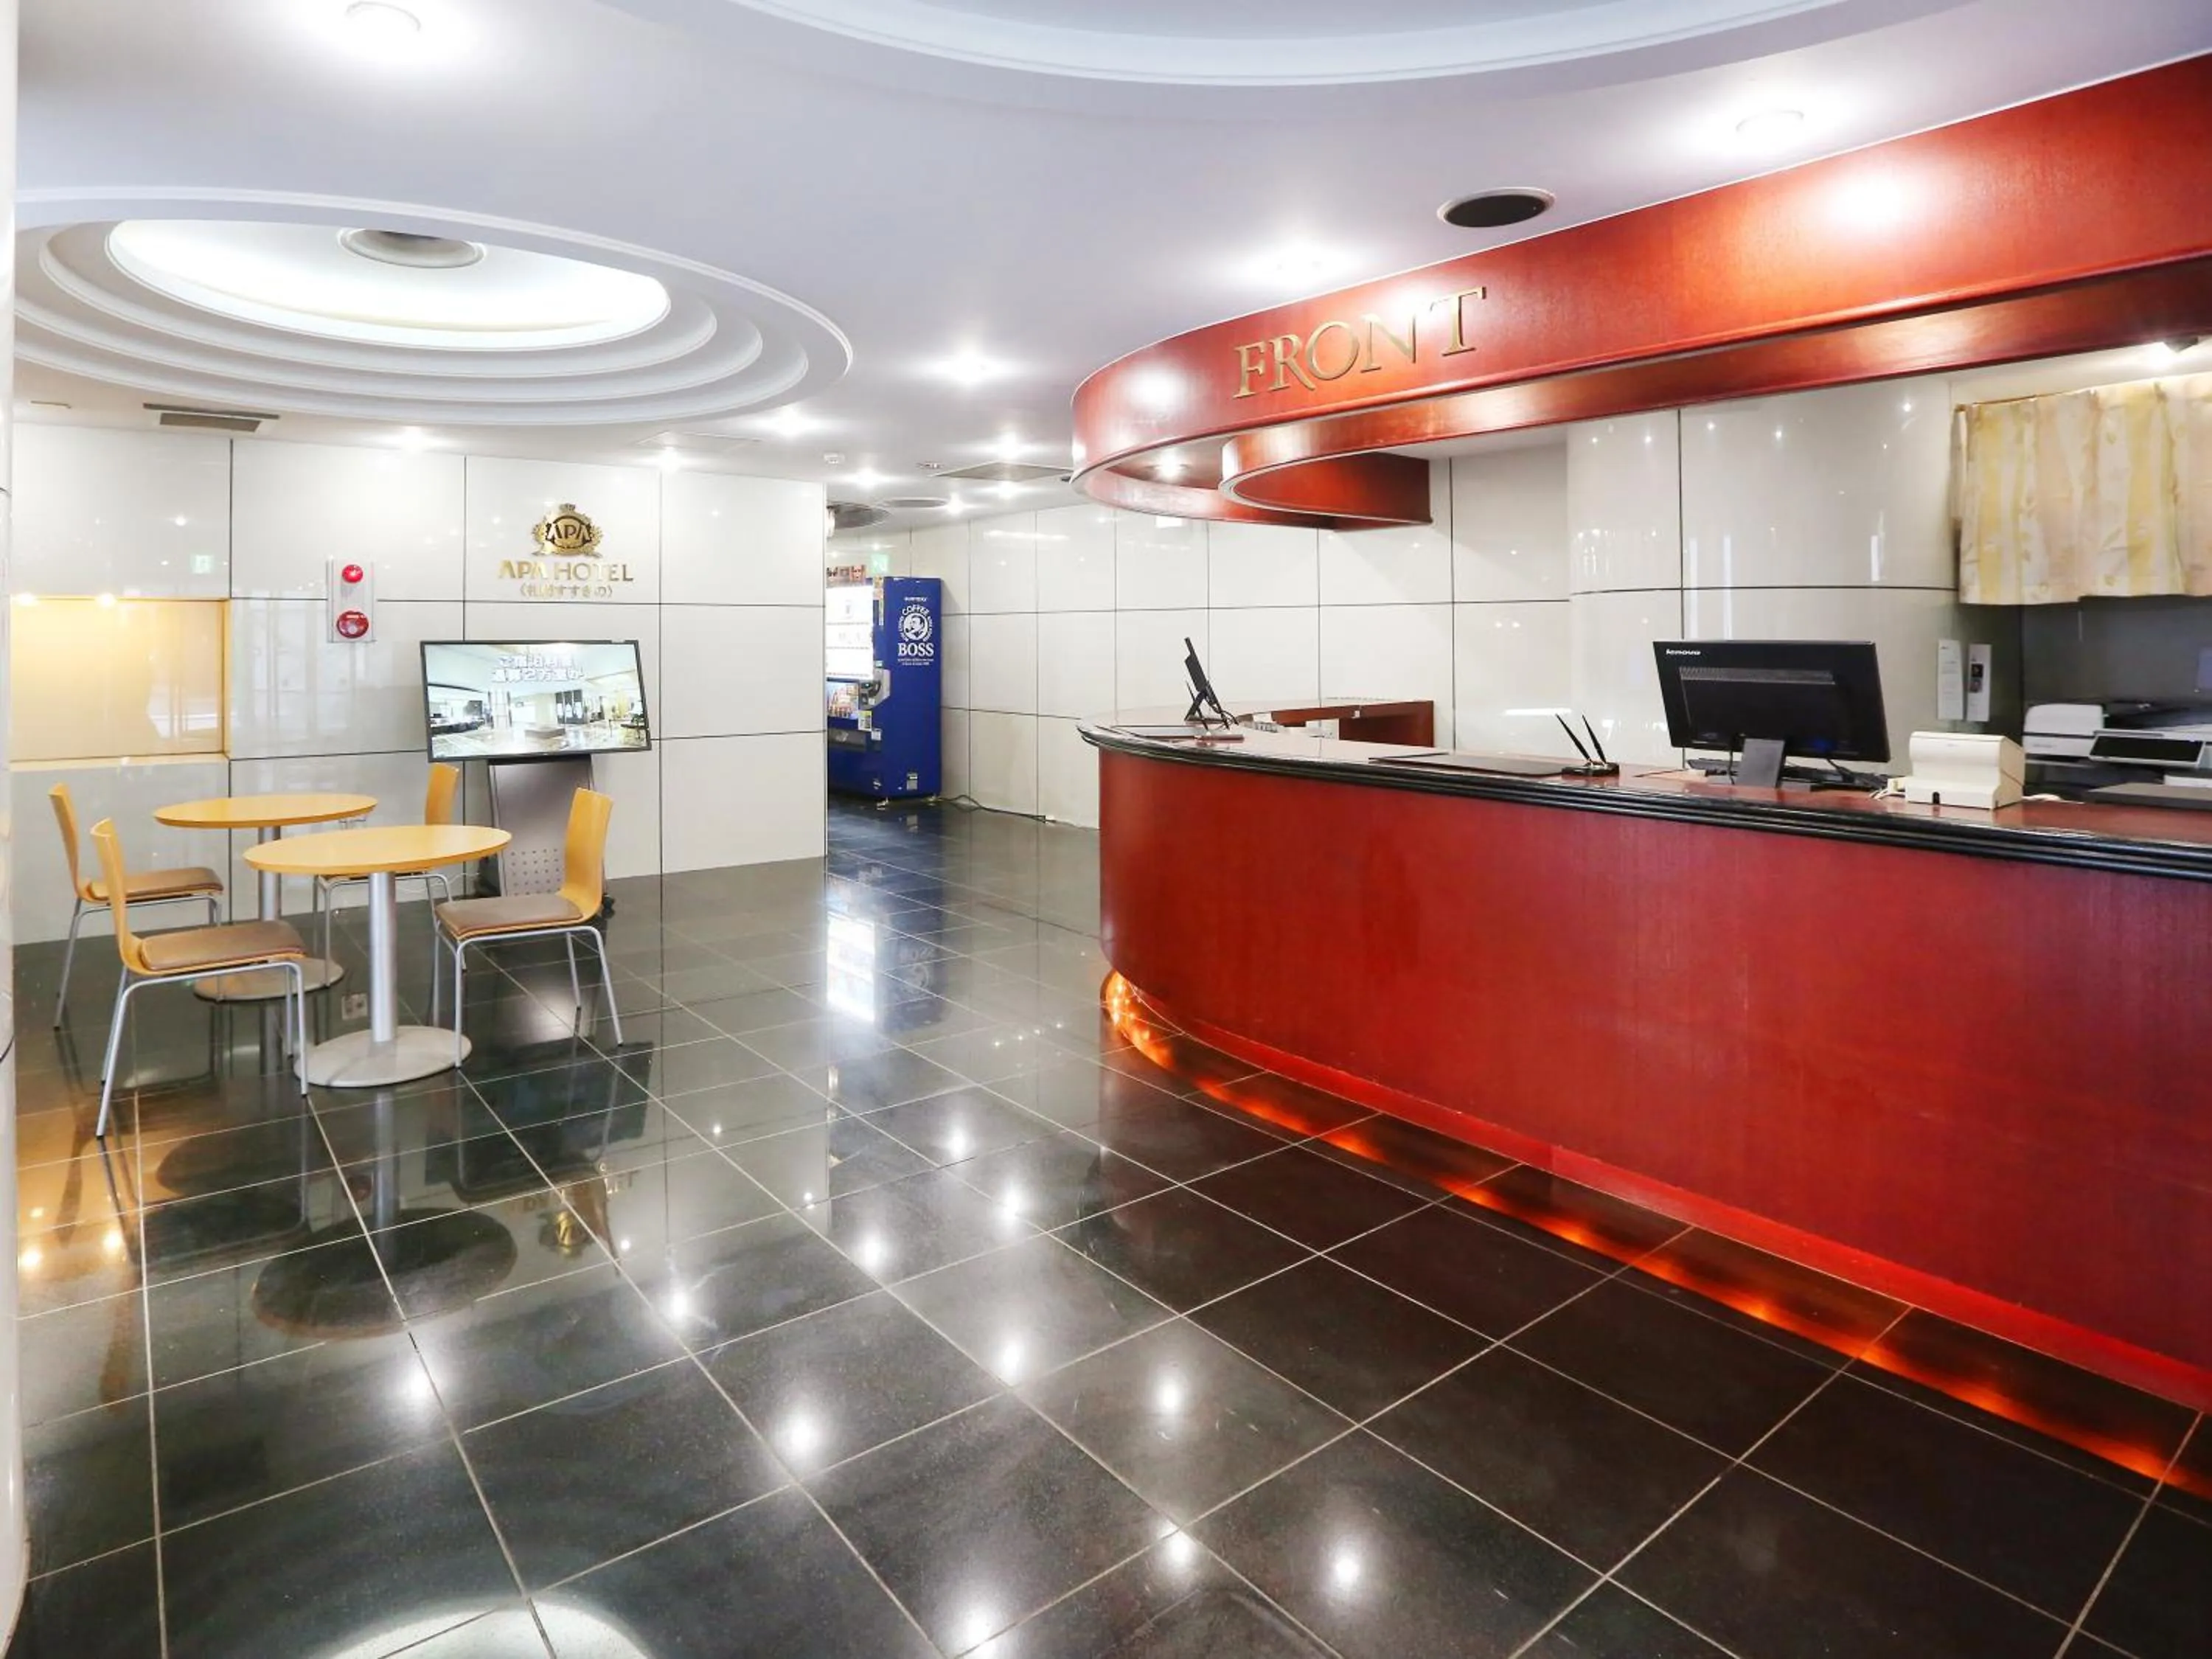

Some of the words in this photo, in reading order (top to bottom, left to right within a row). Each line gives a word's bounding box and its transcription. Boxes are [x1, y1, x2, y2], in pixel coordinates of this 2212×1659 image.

[1233, 286, 1487, 399] FRONT
[498, 560, 548, 580] APA
[554, 562, 634, 582] HOTEL
[897, 642, 934, 657] BOSS
